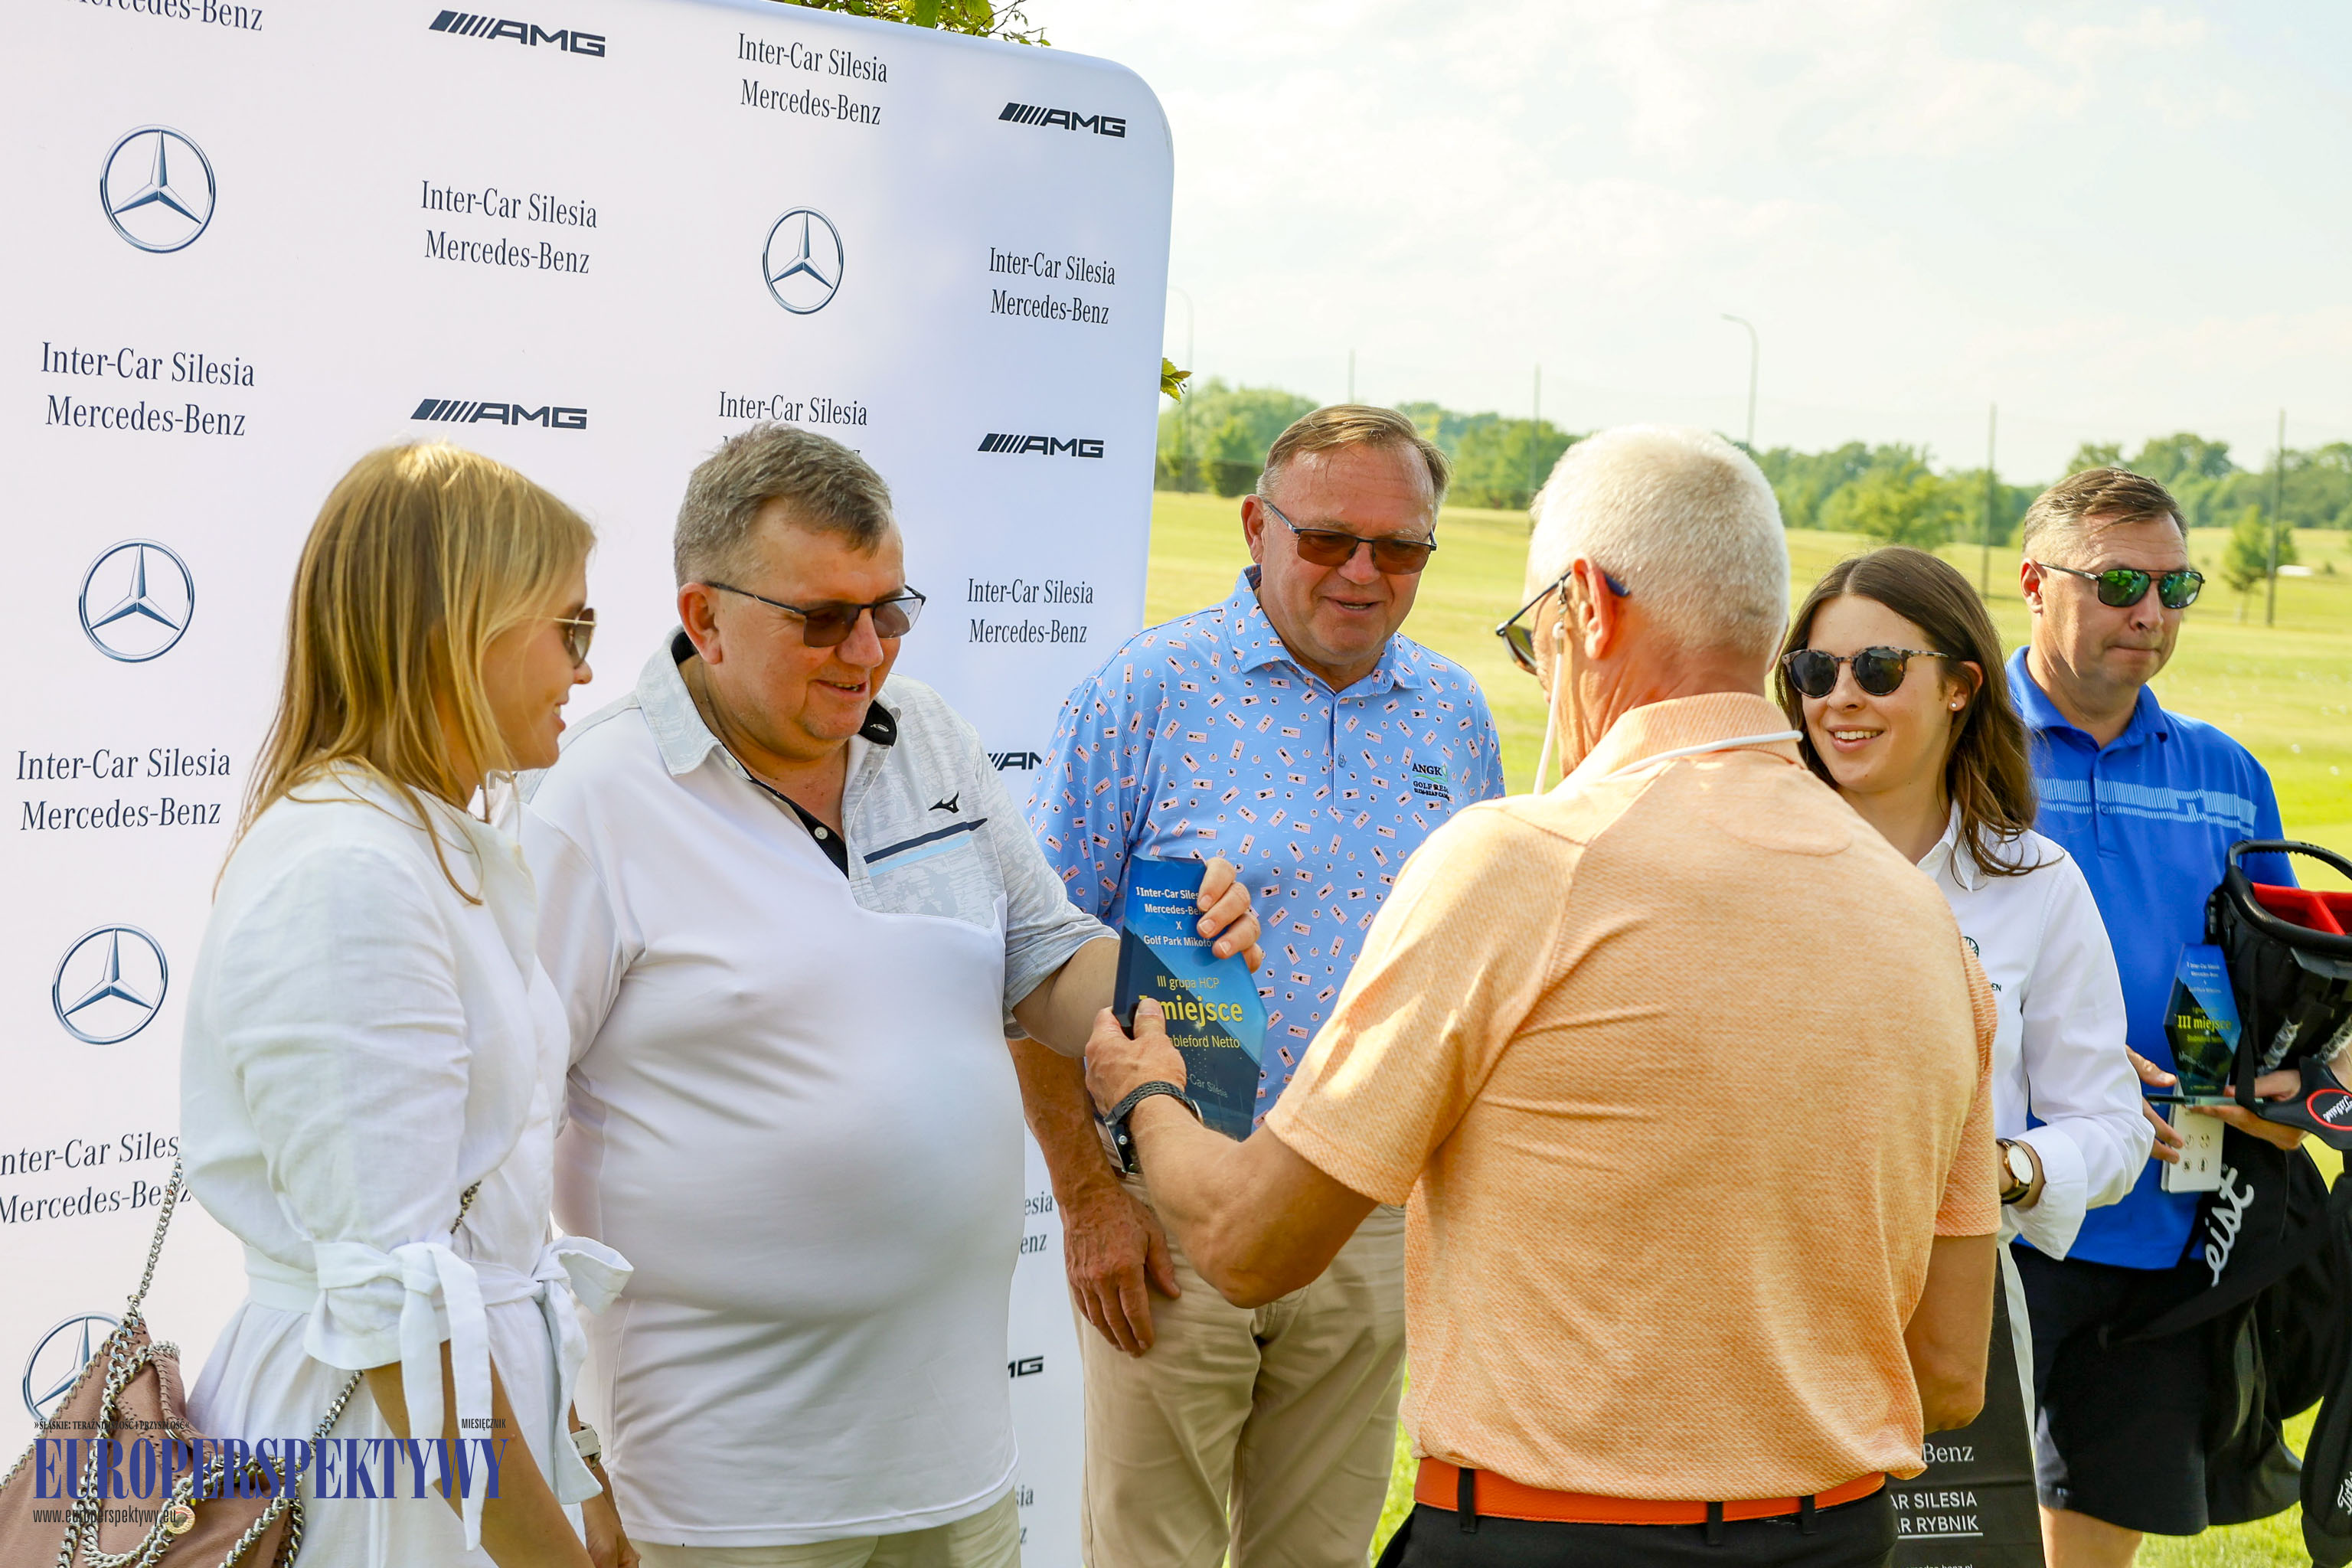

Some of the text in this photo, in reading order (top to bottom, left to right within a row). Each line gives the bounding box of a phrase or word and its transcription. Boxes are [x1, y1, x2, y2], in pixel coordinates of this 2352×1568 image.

[487, 18, 606, 58] AMG
[737, 32, 887, 83] Inter-Car Silesia
[740, 79, 881, 126] Mercedes-Benz
[1040, 109, 1126, 139] AMG
[420, 180, 597, 229] Inter-Car Silesia
[425, 230, 590, 274] Mercedes-Benz
[988, 247, 1116, 286] Inter-Car Silesia
[991, 289, 1109, 325] Mercedes-Benz
[41, 341, 255, 387] Inter-Car Silesia
[45, 394, 246, 436] Mercedes-Benz
[468, 402, 588, 430] AMG
[718, 390, 867, 426] Inter-Car Silesia
[1018, 434, 1105, 459] AMG
[967, 578, 1093, 604] Inter-Car Silesia
[969, 619, 1087, 644] Mercedes-Benz
[16, 747, 230, 780] Inter-Car Silesia
[20, 797, 221, 831] Mercedes-Benz
[1145, 903, 1204, 916] Mercedes-Ben
[1180, 889, 1199, 900] Siles
[1144, 935, 1161, 946] Golf
[1163, 936, 1182, 946] Park
[1157, 975, 1220, 991] III grupa HCP
[1158, 995, 1244, 1027] miejsce
[1211, 1034, 1240, 1048] Netto
[0, 1131, 179, 1176] nter-Car Siles
[1914, 1491, 1978, 1509] SILESIA
[1916, 1514, 1979, 1533] RYBNIK
